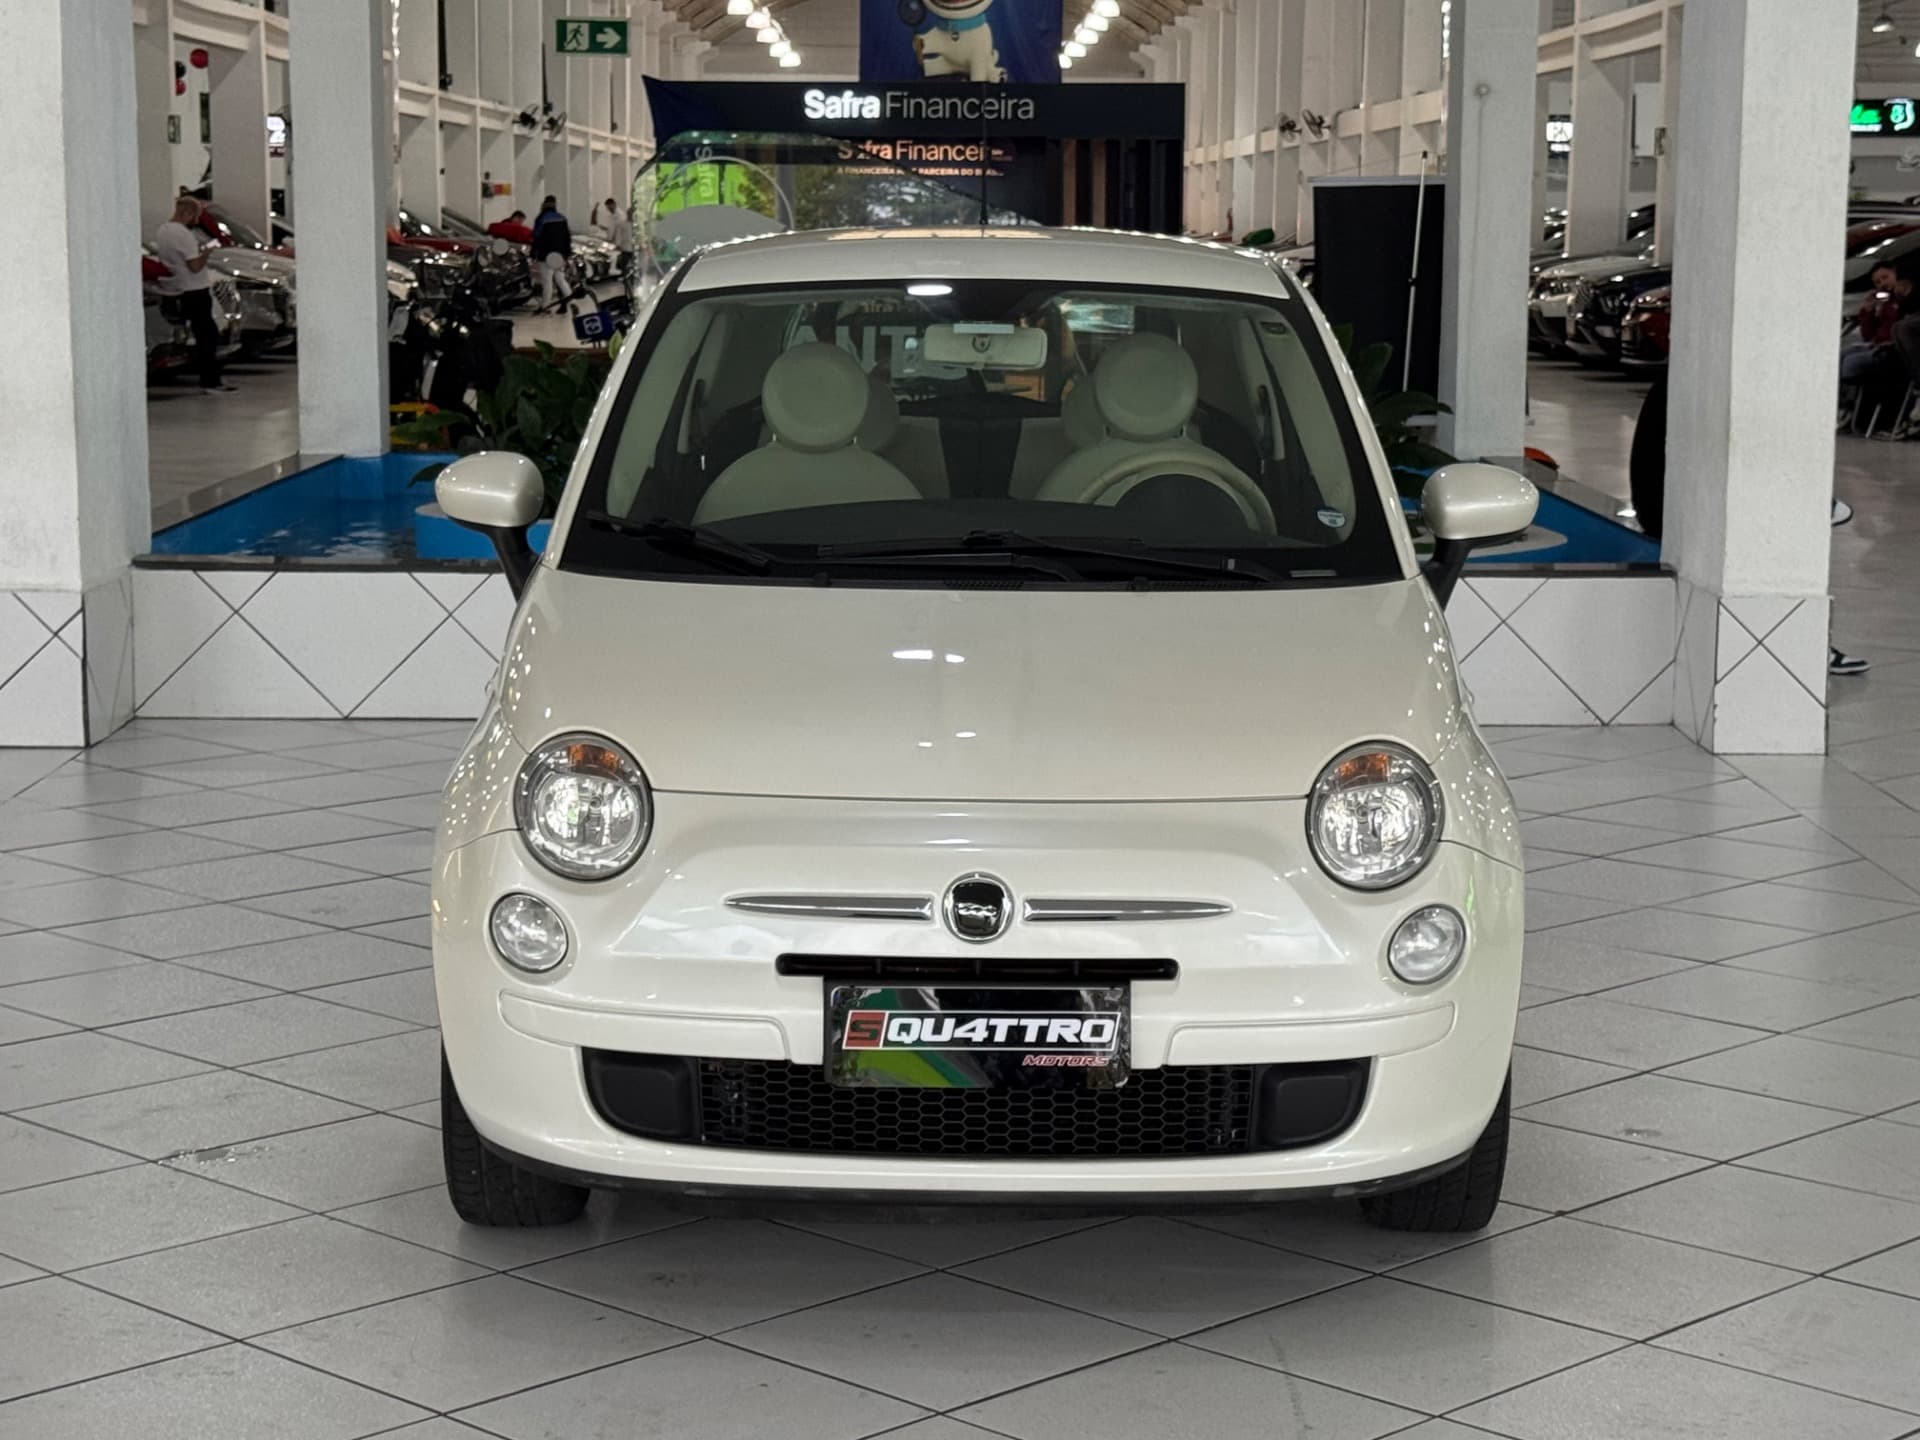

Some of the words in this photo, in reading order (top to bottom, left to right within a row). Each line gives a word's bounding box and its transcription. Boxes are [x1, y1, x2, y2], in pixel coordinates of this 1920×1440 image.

[804, 89, 881, 119] Safra
[886, 91, 1035, 120] Financeira
[896, 140, 985, 161] Financei
[1022, 1055, 1110, 1067] MOTORS
